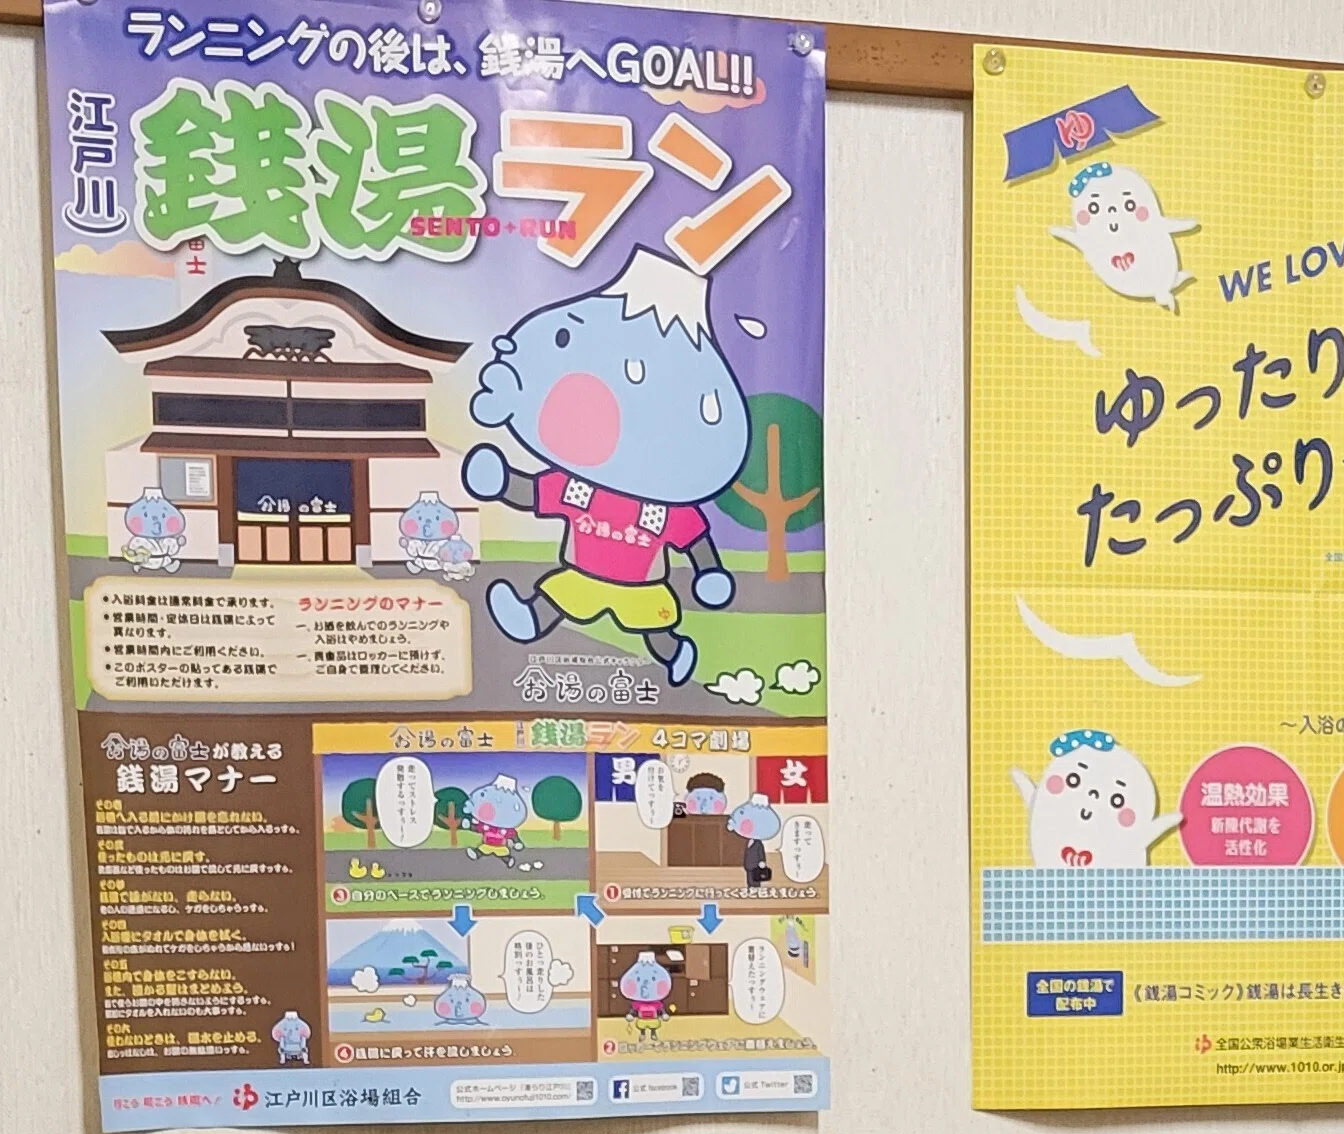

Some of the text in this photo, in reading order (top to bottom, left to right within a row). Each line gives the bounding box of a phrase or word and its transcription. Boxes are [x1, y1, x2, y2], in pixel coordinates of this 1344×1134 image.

[1056, 109, 1096, 151] ゆ
[67, 90, 120, 220] 江戸川
[131, 78, 792, 275] 銭湯ラン
[1218, 260, 1273, 303] WE
[298, 596, 444, 612] ランニングのマナー
[514, 665, 660, 705] お湯の富士
[389, 725, 494, 749] お湯の富士
[115, 765, 279, 795] 銭湯マナー
[611, 756, 637, 787] 男
[779, 758, 810, 789] 女
[1200, 781, 1290, 809] 温熱効果
[1210, 816, 1282, 836] 新陳代謝を
[1224, 838, 1268, 858] 活性化
[1034, 978, 1116, 995] 全国の銭湯で
[1055, 995, 1098, 1013] 配布中
[264, 1086, 423, 1109] 江戸川区浴場組合
[760, 1079, 790, 1089] Twitter
